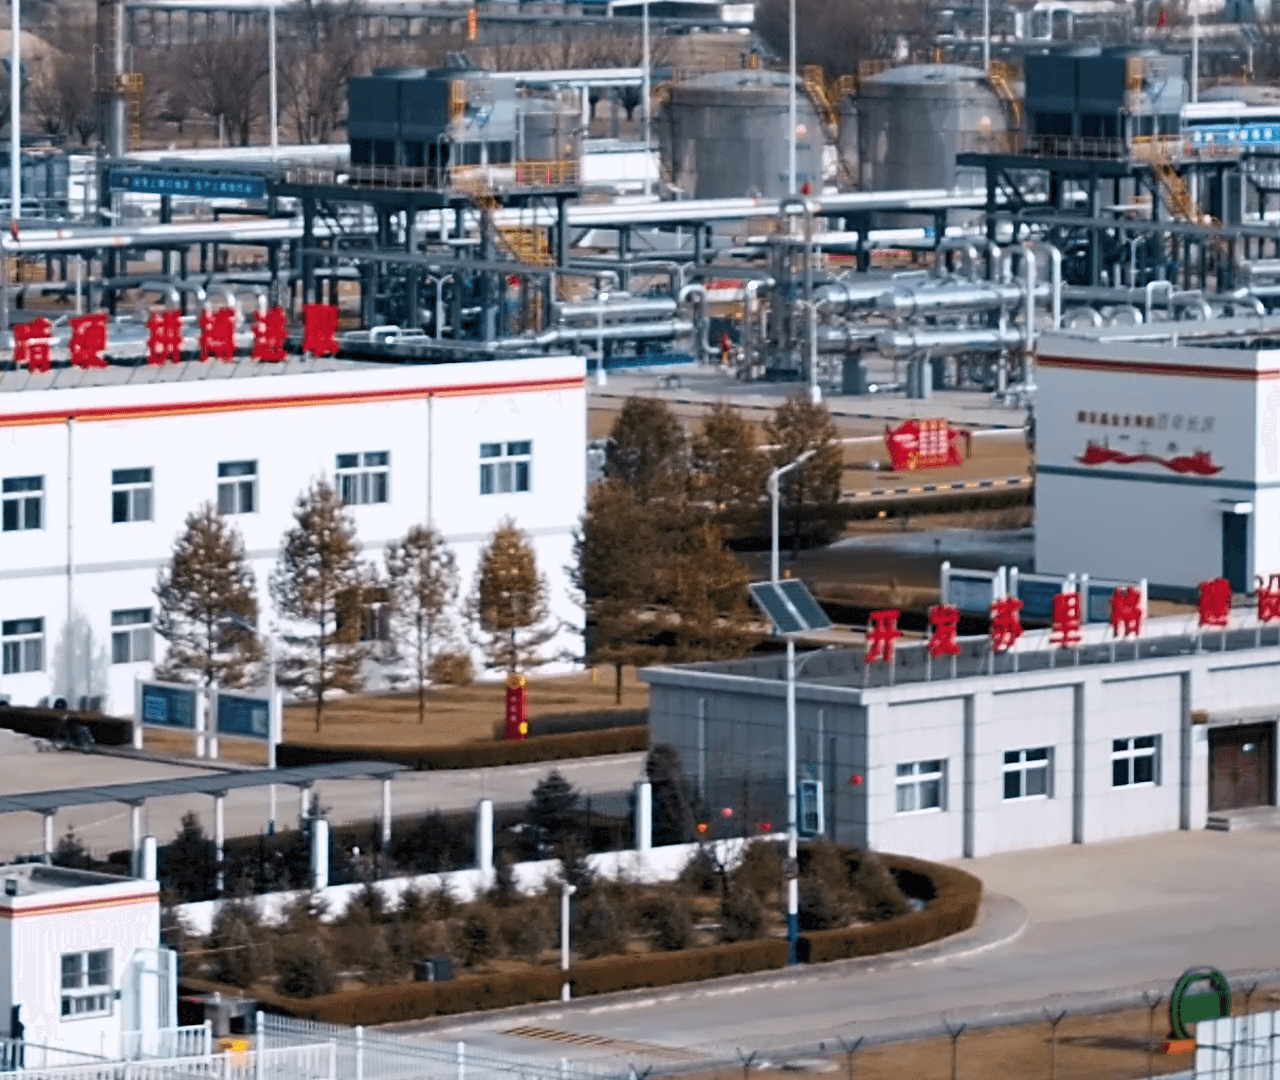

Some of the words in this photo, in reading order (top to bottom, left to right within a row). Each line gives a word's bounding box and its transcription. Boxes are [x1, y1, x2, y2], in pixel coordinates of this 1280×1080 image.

[865, 584, 1143, 664] 开发苏里格
